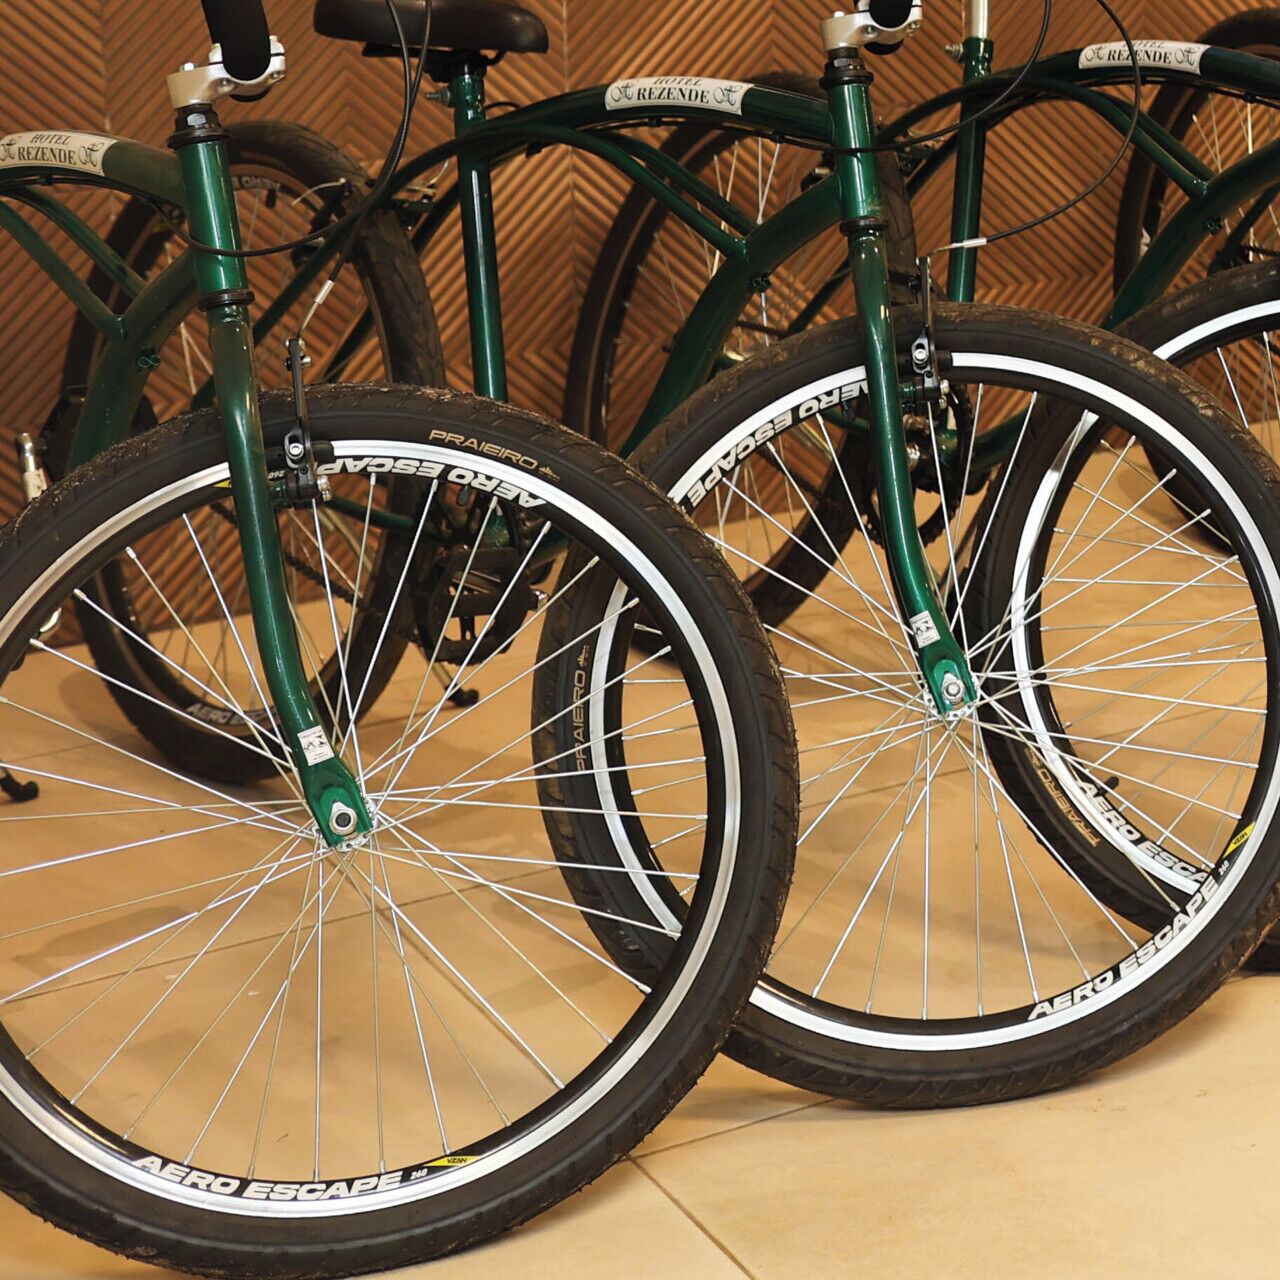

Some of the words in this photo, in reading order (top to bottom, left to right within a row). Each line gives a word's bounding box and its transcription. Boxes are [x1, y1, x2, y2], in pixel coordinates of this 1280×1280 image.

[636, 86, 710, 104] REZENDE
[17, 145, 77, 166] REZENDE
[30, 132, 72, 146] HOTEL
[316, 456, 446, 479] ESCAP
[428, 429, 538, 471] PRAIEIRO
[688, 406, 794, 504] ESCAPE
[446, 466, 548, 509] AERO
[1038, 766, 1101, 848] PRAIEIRO
[1077, 778, 1142, 842] AERO
[1137, 841, 1211, 885] ESCA
[1027, 972, 1116, 1021] AERO
[1118, 874, 1220, 978] ESCAPE
[132, 1155, 236, 1196] AERO
[241, 1170, 404, 1201] ESCAPE
[409, 1168, 429, 1180] 260
